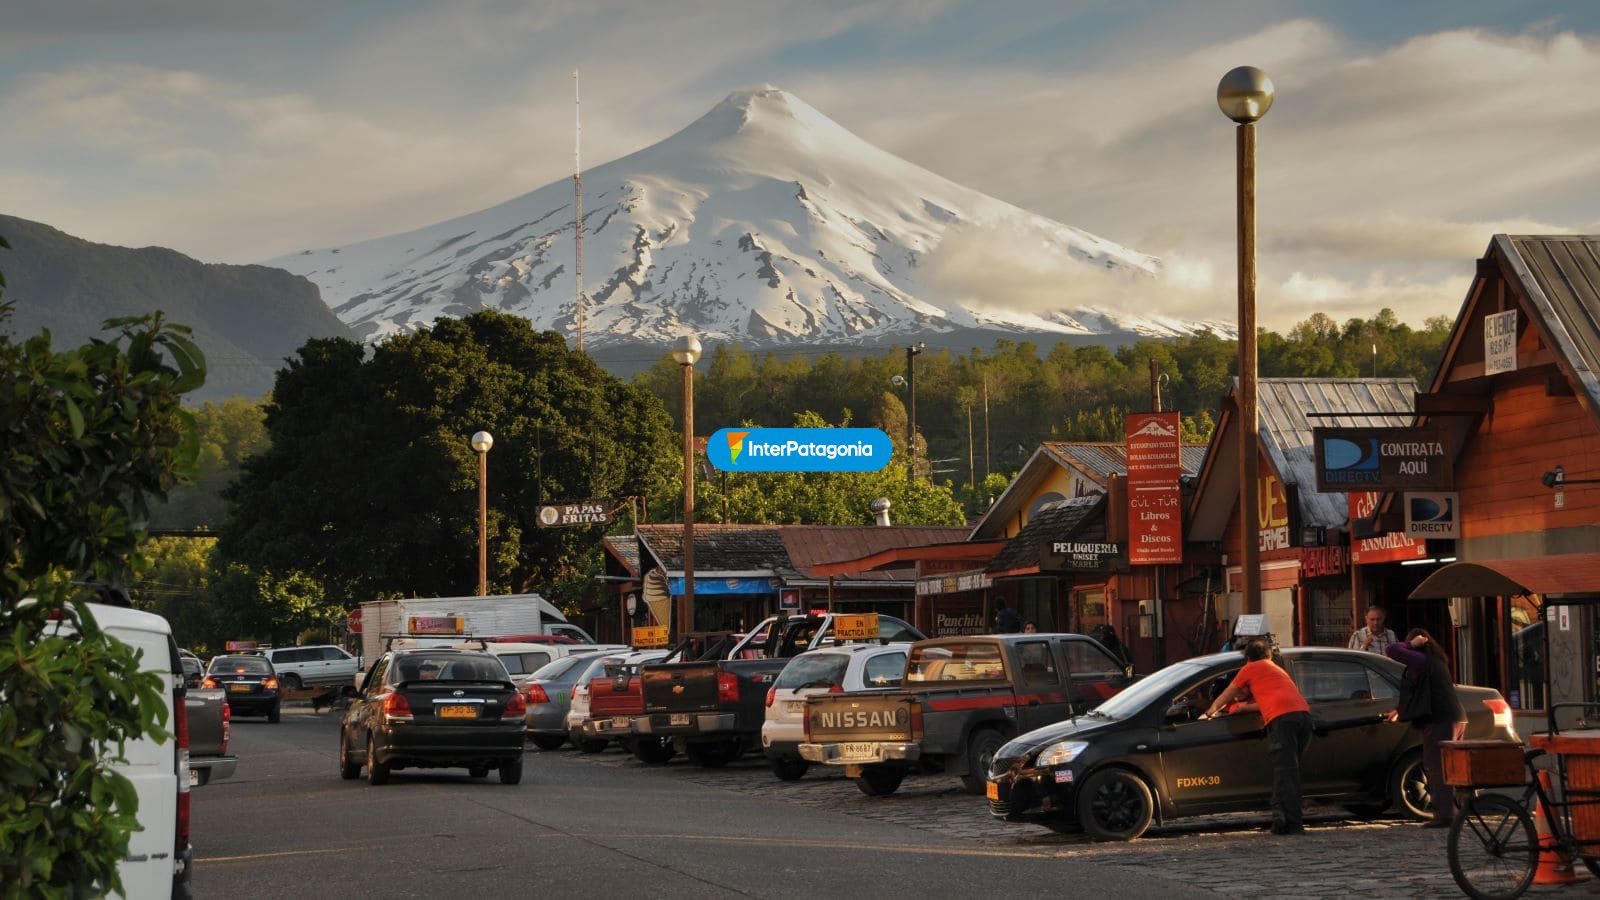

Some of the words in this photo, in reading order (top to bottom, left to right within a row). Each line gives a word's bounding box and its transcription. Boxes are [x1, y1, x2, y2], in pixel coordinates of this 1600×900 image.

[1380, 442, 1444, 456] CONTRATA
[1398, 458, 1428, 475] AQUÍ
[1325, 470, 1381, 482] DIRECTV
[565, 505, 603, 515] PAPAS
[562, 514, 607, 524] FRITAS
[1140, 511, 1170, 520] Libros
[1411, 523, 1453, 532] DIRECTV
[1140, 534, 1171, 543] Discos
[1053, 542, 1119, 554] PELUQUERIA
[837, 629, 865, 637] PRACTICA
[821, 711, 897, 728] NISSAN
